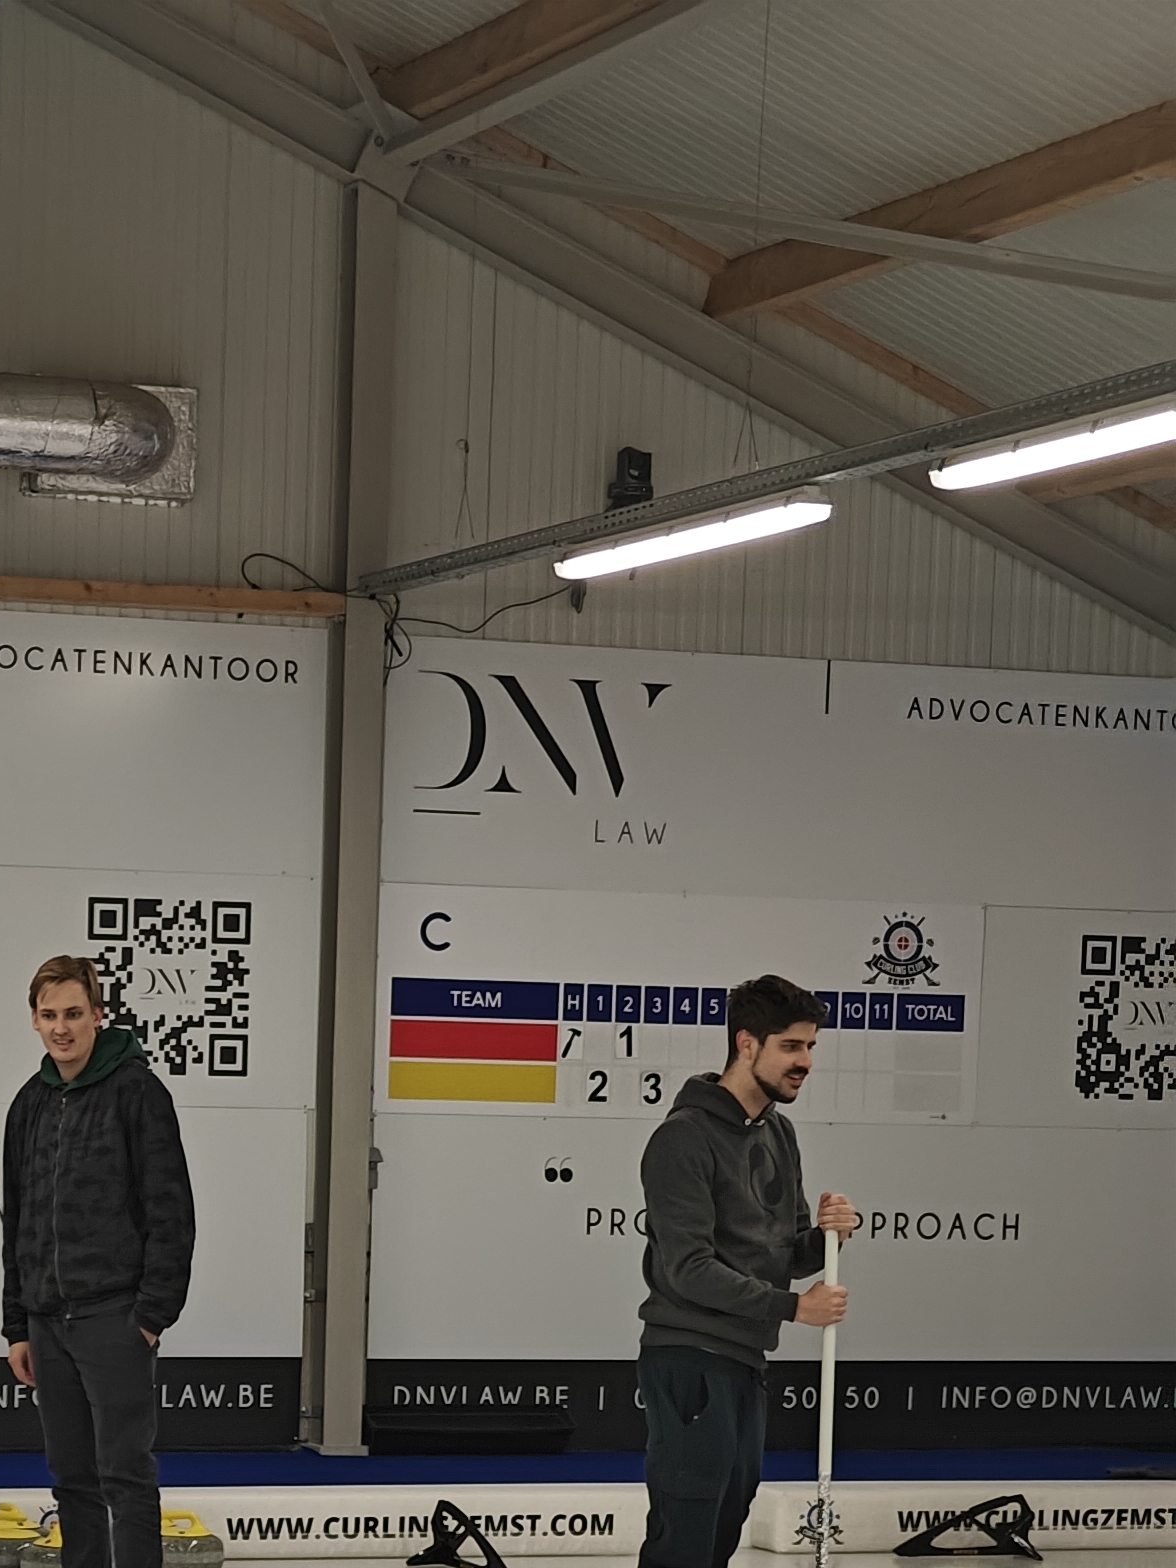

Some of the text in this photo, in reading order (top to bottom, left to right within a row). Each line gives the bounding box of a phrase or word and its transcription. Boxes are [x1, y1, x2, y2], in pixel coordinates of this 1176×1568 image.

[907, 697, 1176, 732] ADVOCATENKANT
[594, 819, 667, 845] LAW
[420, 912, 452, 951] C
[450, 990, 502, 1008] TEAM
[567, 994, 580, 1011] H
[596, 995, 604, 1012] 1
[623, 996, 634, 1013] 2
[652, 997, 662, 1013] 3
[680, 998, 691, 1014] 4
[709, 998, 719, 1015] 5
[844, 1002, 864, 1019] 10
[873, 1003, 889, 1020] 11
[905, 1004, 956, 1021] TOTAL
[619, 1025, 633, 1057] 1
[587, 1070, 662, 1104] 2 3
[851, 1210, 1020, 1242] PPROACH
[393, 1386, 1176, 1410] DNVLAWBE 50 50 INFO@DNVLAW.
